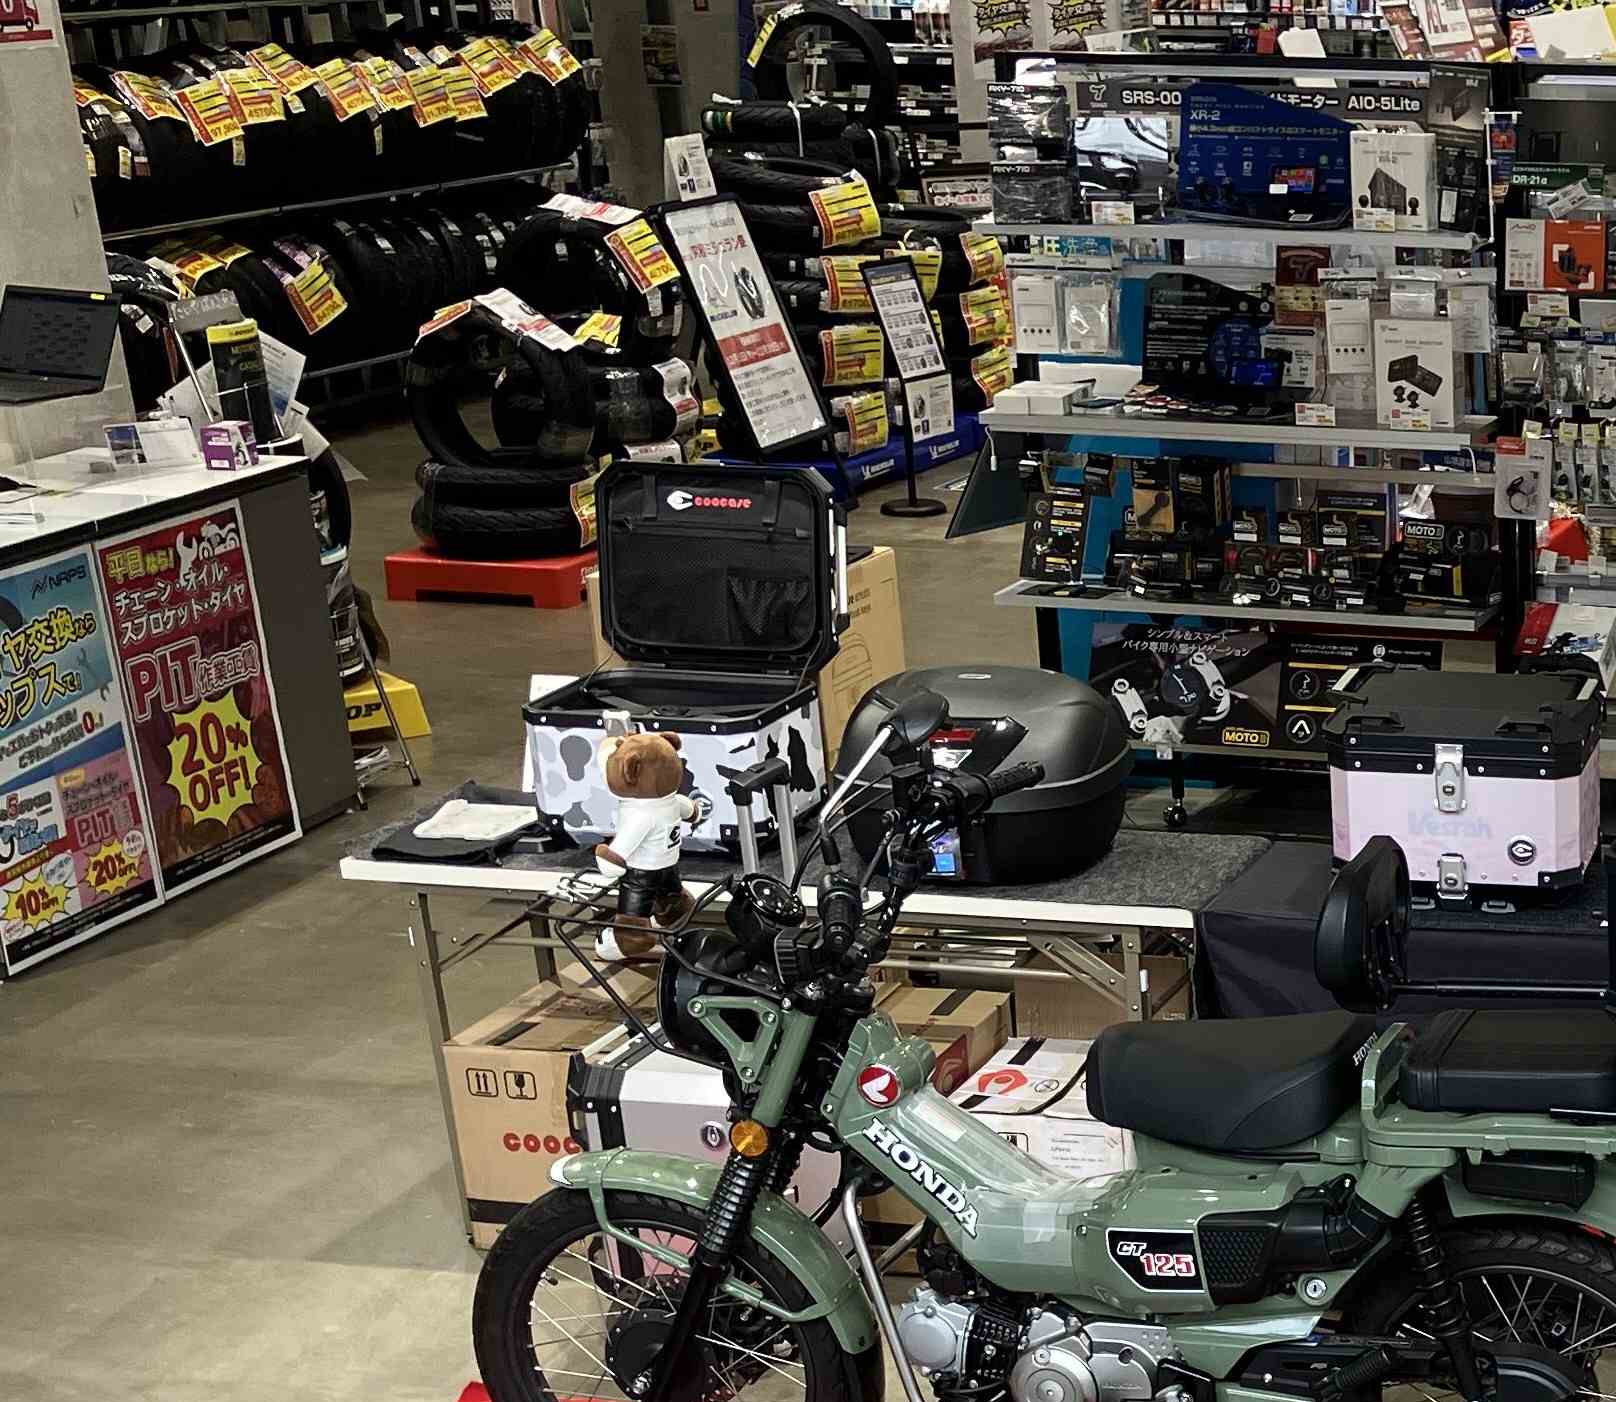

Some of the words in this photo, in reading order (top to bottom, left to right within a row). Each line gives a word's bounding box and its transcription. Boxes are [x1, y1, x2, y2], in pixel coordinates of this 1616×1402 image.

[1122, 89, 1183, 106] SRS-00
[1347, 95, 1422, 113] AIO-5Lite
[694, 496, 752, 509] coocase
[1406, 524, 1436, 536] MOTO
[2, 605, 96, 671] ヤ交換なら
[346, 702, 382, 720] OP
[174, 711, 249, 778] 20%
[1224, 730, 1259, 744] MOTO
[189, 761, 252, 813] OFF!
[503, 1132, 580, 1156] cooc
[862, 1118, 979, 1238] HONDA
[1116, 1240, 1147, 1257] CT
[1139, 1252, 1197, 1277] 125
